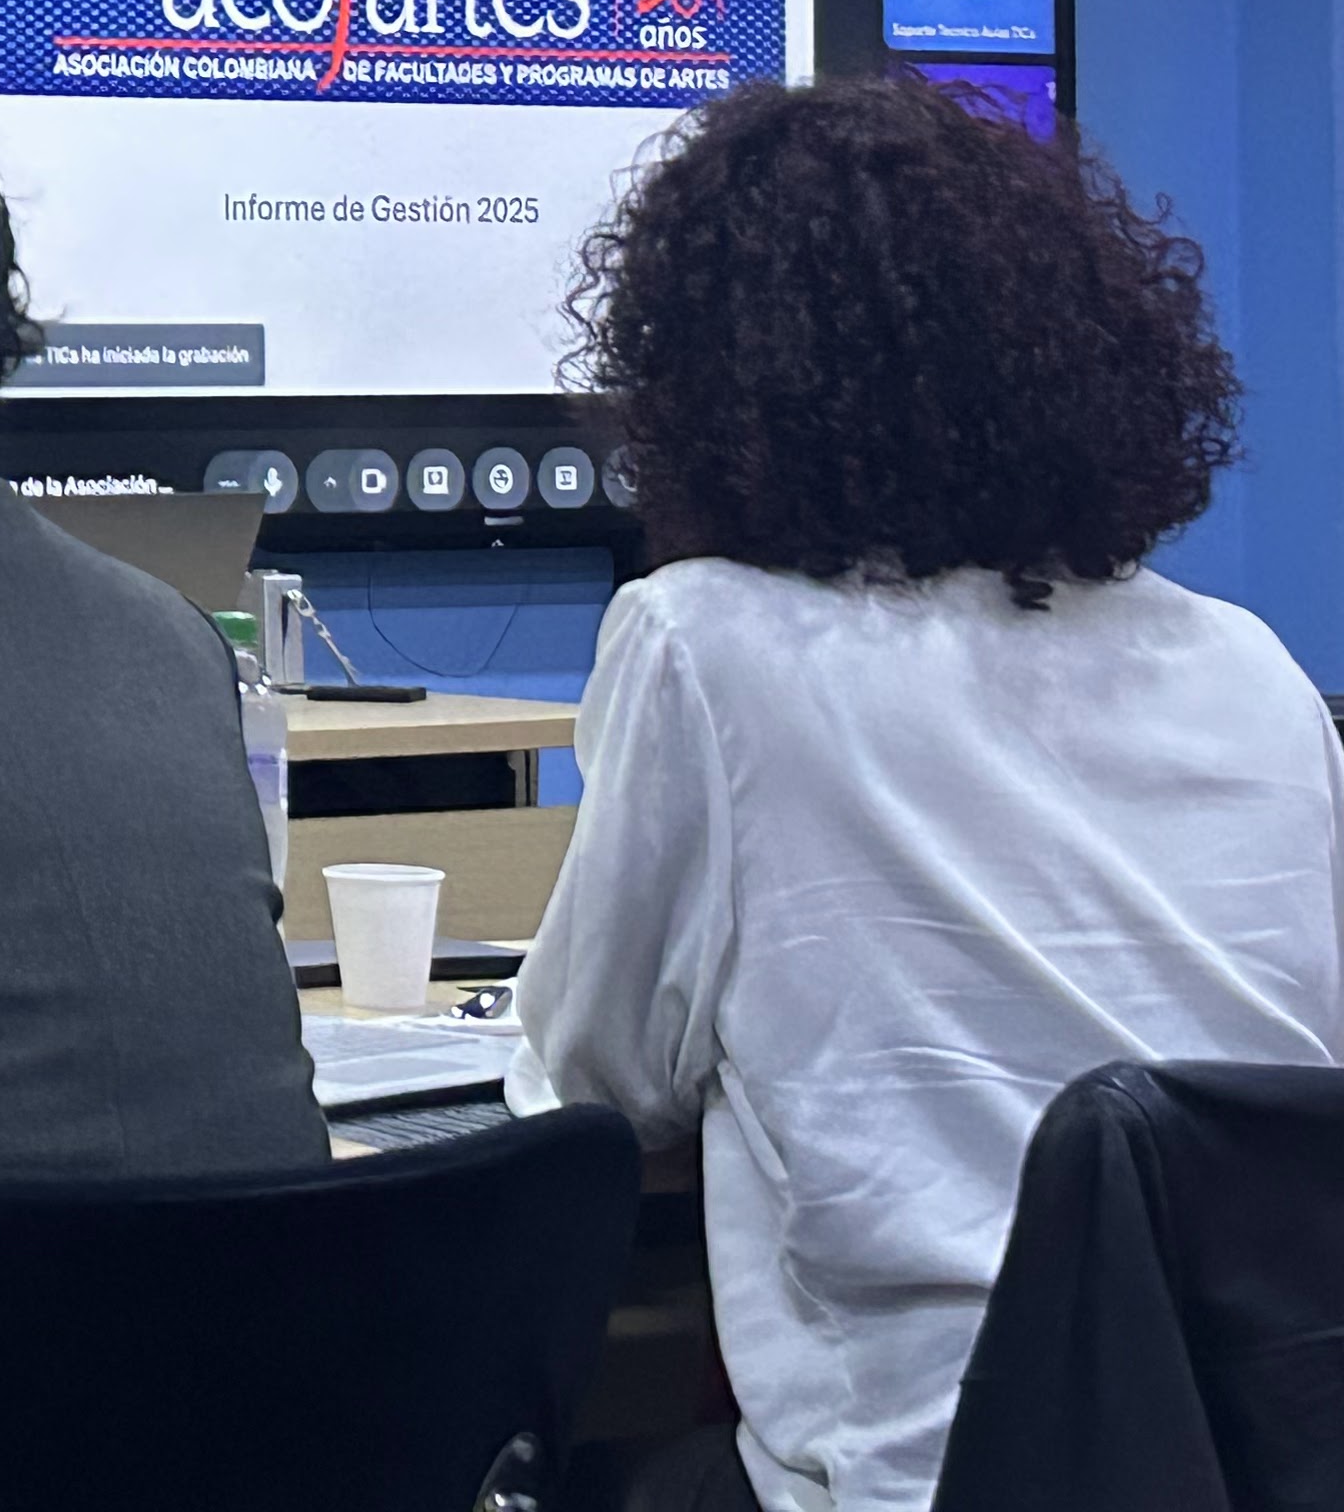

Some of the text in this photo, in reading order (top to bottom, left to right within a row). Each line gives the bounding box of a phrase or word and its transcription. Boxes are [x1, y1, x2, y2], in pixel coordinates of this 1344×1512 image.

[639, 17, 708, 50] años
[53, 50, 181, 79] ASOCIACIÓN
[183, 54, 318, 81] COLOMBIANA
[342, 60, 372, 82] DE
[499, 63, 515, 85] Y
[516, 64, 638, 87] PROGRAMAS
[640, 67, 666, 88] DE
[668, 67, 731, 89] ARTES
[224, 192, 540, 224] Informe de Gestión 2025
[81, 345, 101, 364] ha
[162, 345, 176, 364] la
[20, 476, 43, 498] de
[46, 475, 62, 497] la
